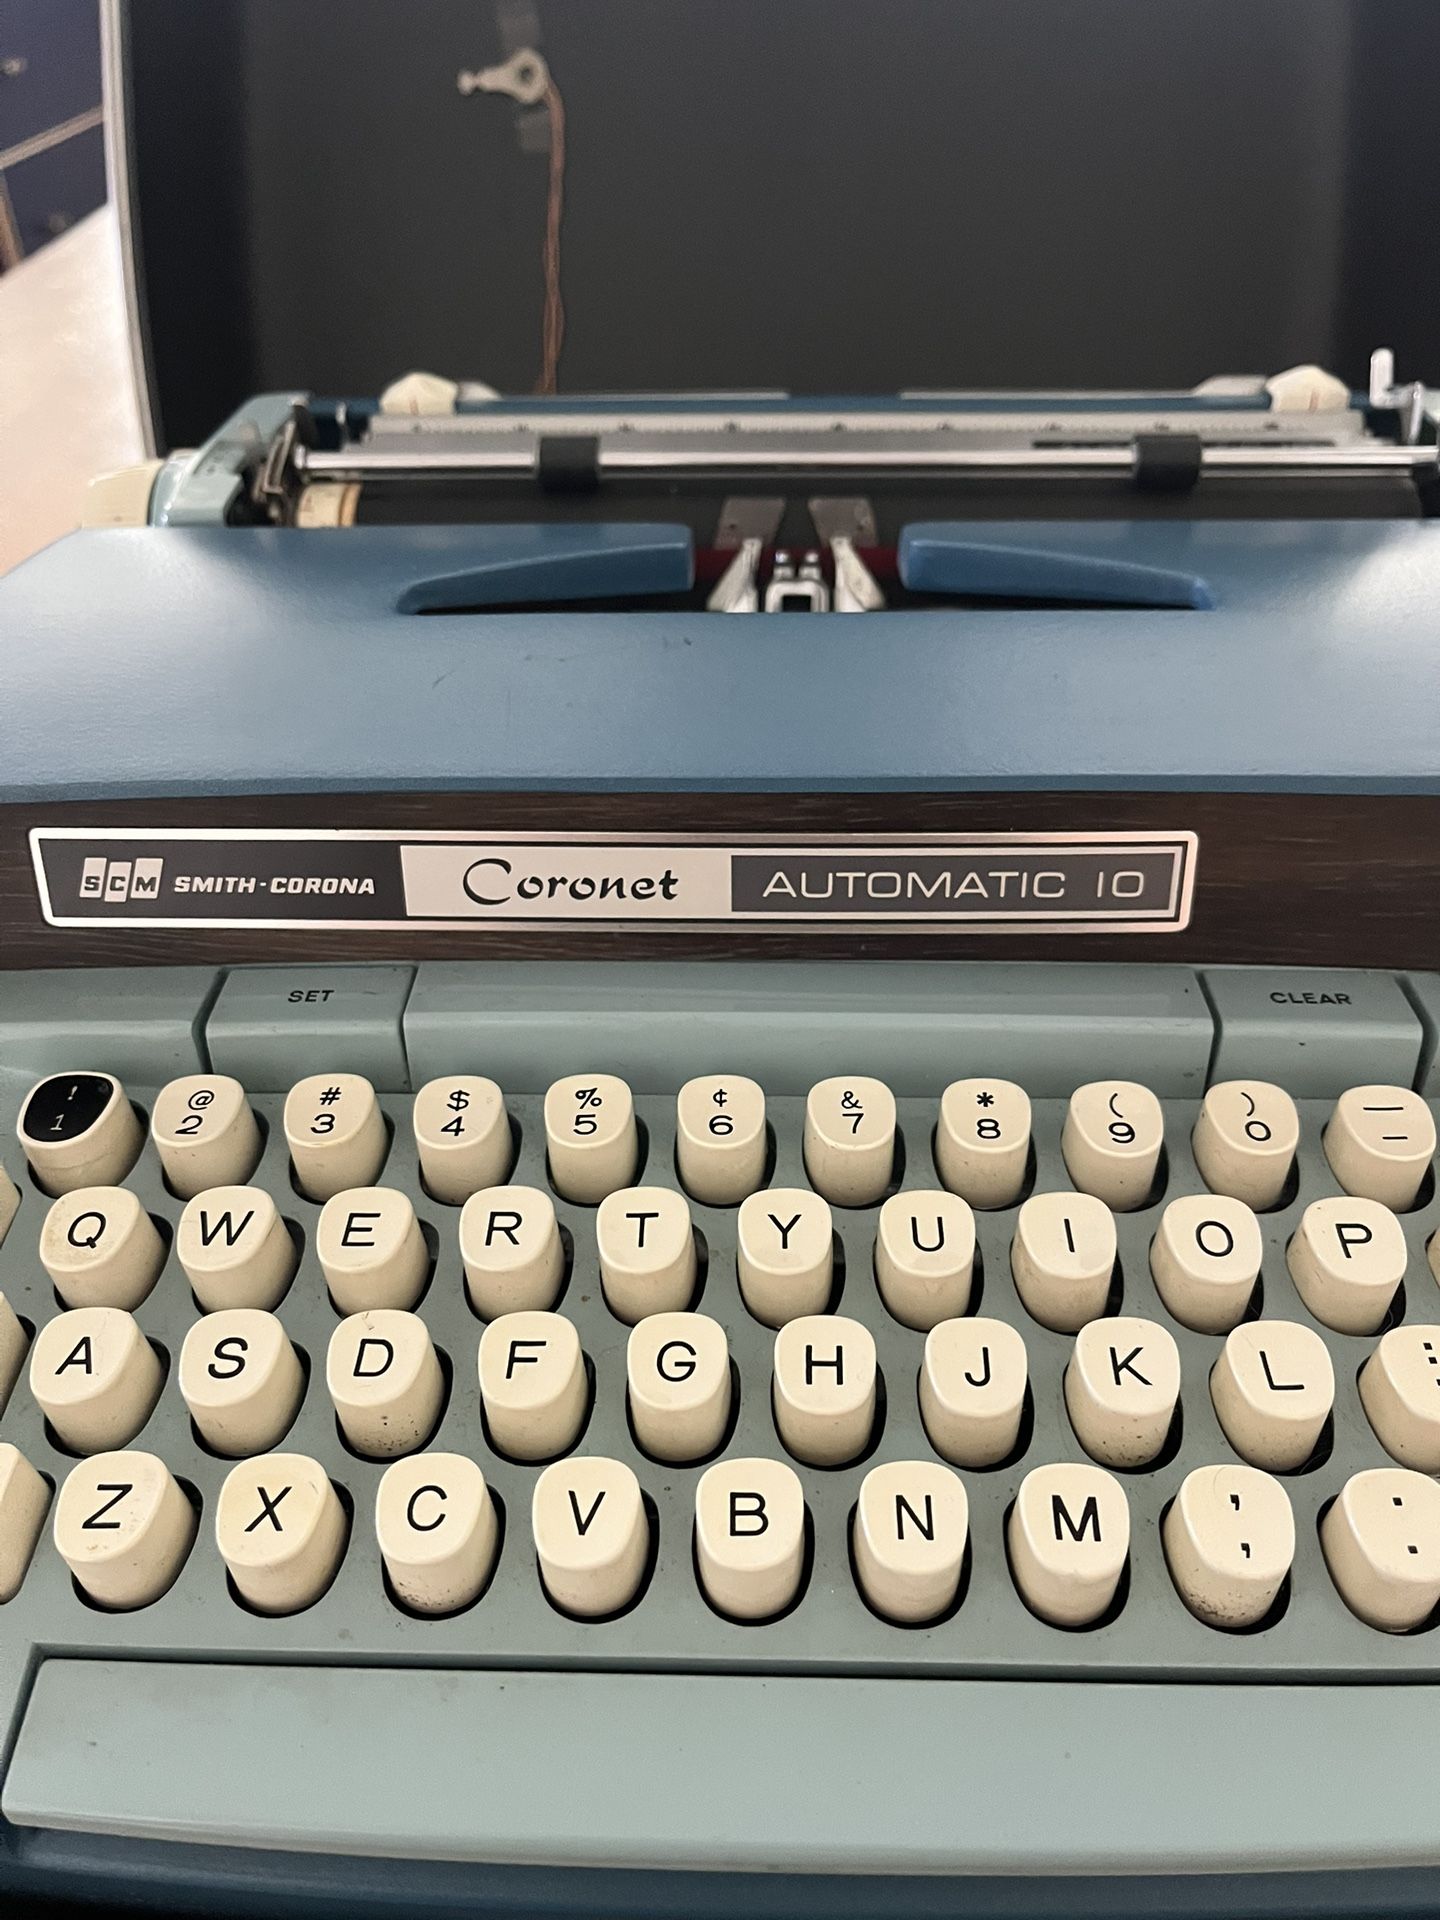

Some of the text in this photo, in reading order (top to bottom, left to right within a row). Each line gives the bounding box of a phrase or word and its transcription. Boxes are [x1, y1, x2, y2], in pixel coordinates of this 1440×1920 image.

[173, 876, 375, 895] SMITH-CORONA
[462, 858, 679, 906] Coronet
[762, 871, 1066, 899] AUTOMATIC
[287, 989, 335, 1003] SET
[1269, 992, 1352, 1005] CLEAR
[67, 1086, 78, 1101] !
[187, 1089, 215, 1111] @
[319, 1086, 342, 1106] #
[446, 1089, 471, 1112] $
[574, 1087, 603, 1110] %
[712, 1088, 728, 1108] ¢
[841, 1090, 863, 1110] &
[1109, 1092, 1124, 1119] (
[1240, 1092, 1255, 1117] )
[50, 1114, 64, 1131] 1
[174, 1114, 203, 1135] 2
[310, 1113, 336, 1134] 3
[440, 1115, 465, 1137] 4
[572, 1113, 598, 1136] 5
[708, 1114, 734, 1136] 6
[841, 1112, 865, 1134] 7
[976, 1118, 1002, 1140] 8
[1108, 1121, 1136, 1144] 9
[67, 1211, 107, 1249] Q
[200, 1210, 255, 1247] W
[341, 1212, 381, 1247] E
[484, 1211, 523, 1247] R
[625, 1212, 660, 1248] T
[767, 1213, 802, 1250] Y
[910, 1216, 945, 1253] U
[1063, 1218, 1076, 1253] I
[1195, 1220, 1234, 1258] O
[1335, 1223, 1373, 1259] P
[54, 1336, 93, 1375] A
[207, 1337, 249, 1380] S
[352, 1338, 394, 1378] D
[505, 1340, 547, 1380] F
[656, 1340, 697, 1383] G
[805, 1344, 844, 1386] H
[964, 1346, 991, 1387] J
[1109, 1346, 1153, 1386] K
[1259, 1350, 1305, 1391] L
[81, 1483, 133, 1530] Z
[244, 1486, 293, 1532] X
[406, 1484, 448, 1532] C
[568, 1490, 606, 1536] V
[729, 1491, 769, 1537] B
[895, 1494, 935, 1541] N
[1051, 1494, 1102, 1542] M
